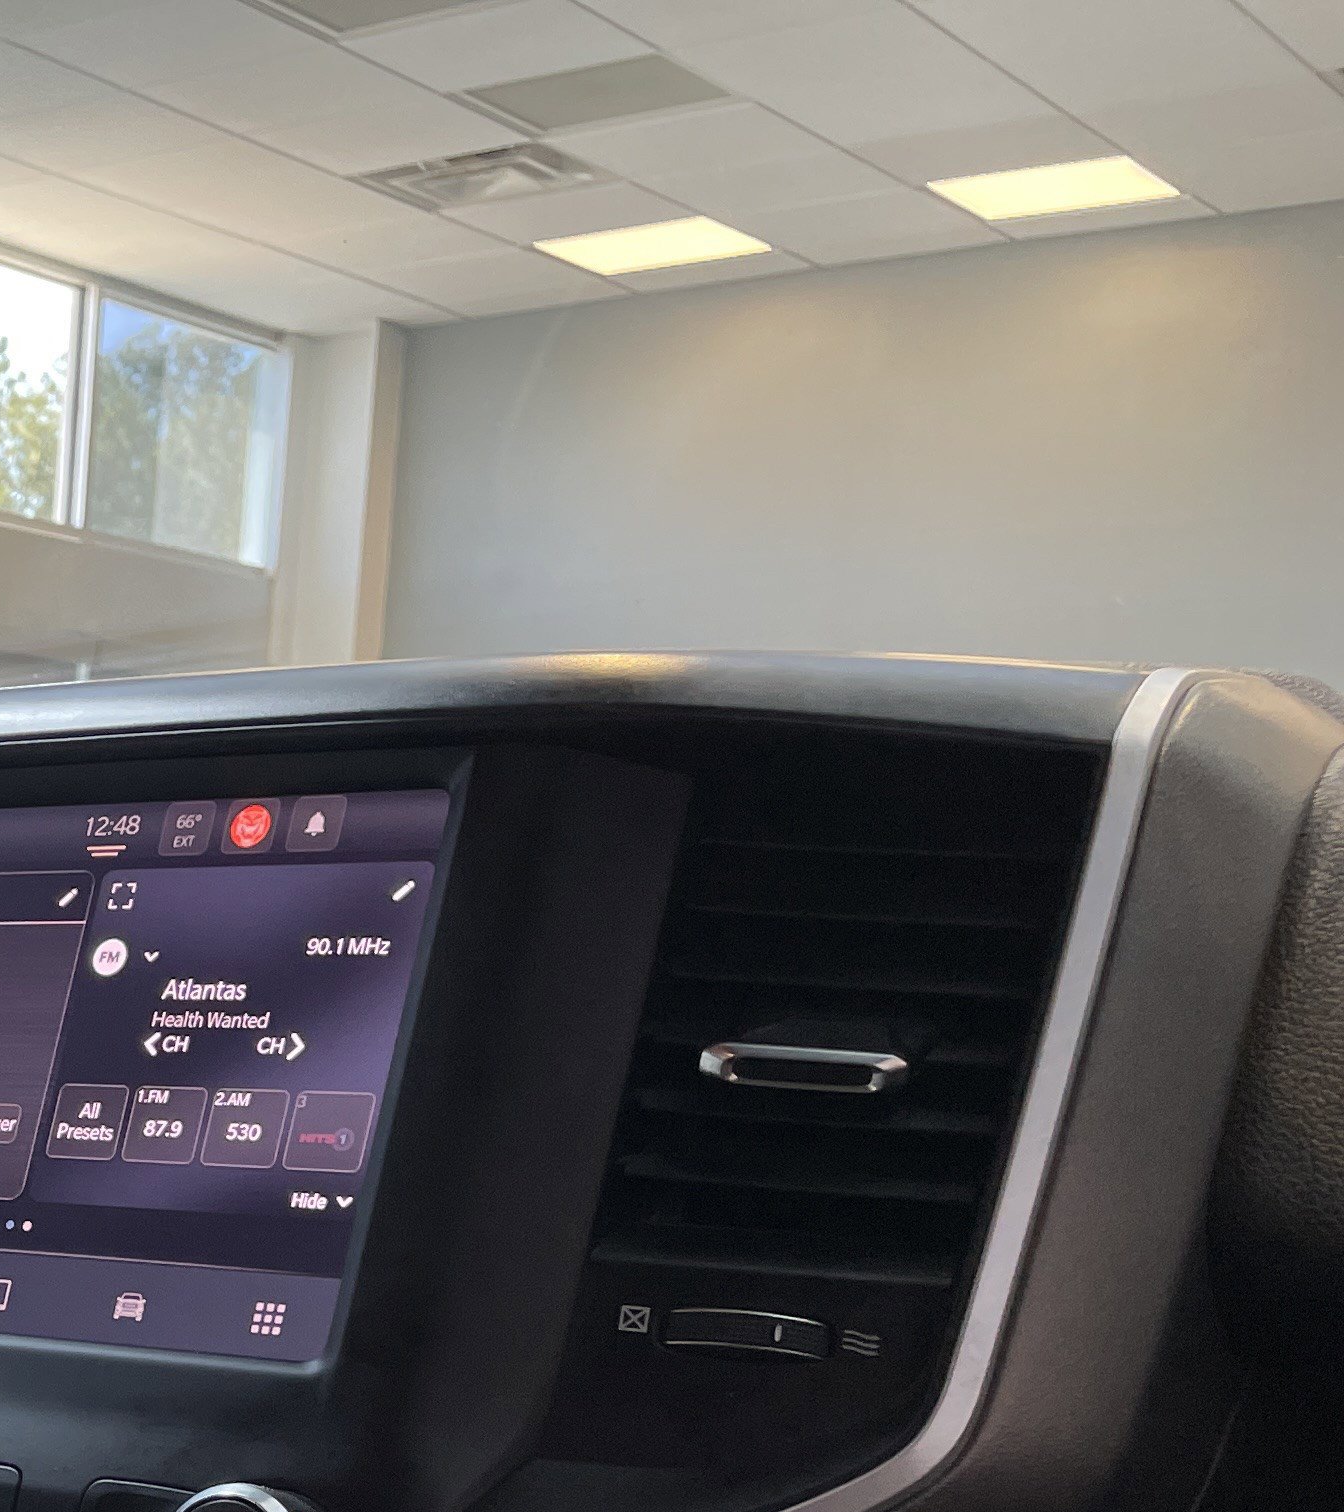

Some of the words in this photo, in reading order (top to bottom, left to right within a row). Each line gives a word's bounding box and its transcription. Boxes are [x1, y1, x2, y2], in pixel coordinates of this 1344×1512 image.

[85, 814, 141, 836] 12:48
[172, 835, 195, 848] EXT
[305, 938, 343, 955] 90.1
[347, 937, 391, 955] MHz
[98, 951, 122, 963] FM
[161, 978, 248, 1001] Atlantas
[151, 1011, 204, 1028] Health
[207, 1011, 270, 1029] Wanted
[162, 1036, 190, 1053] CH
[256, 1037, 285, 1055] CH
[78, 1102, 100, 1119] All
[56, 1122, 114, 1142] Presets
[143, 1120, 183, 1138] 87.9
[225, 1123, 262, 1142] 530
[290, 1192, 328, 1210] Hide
